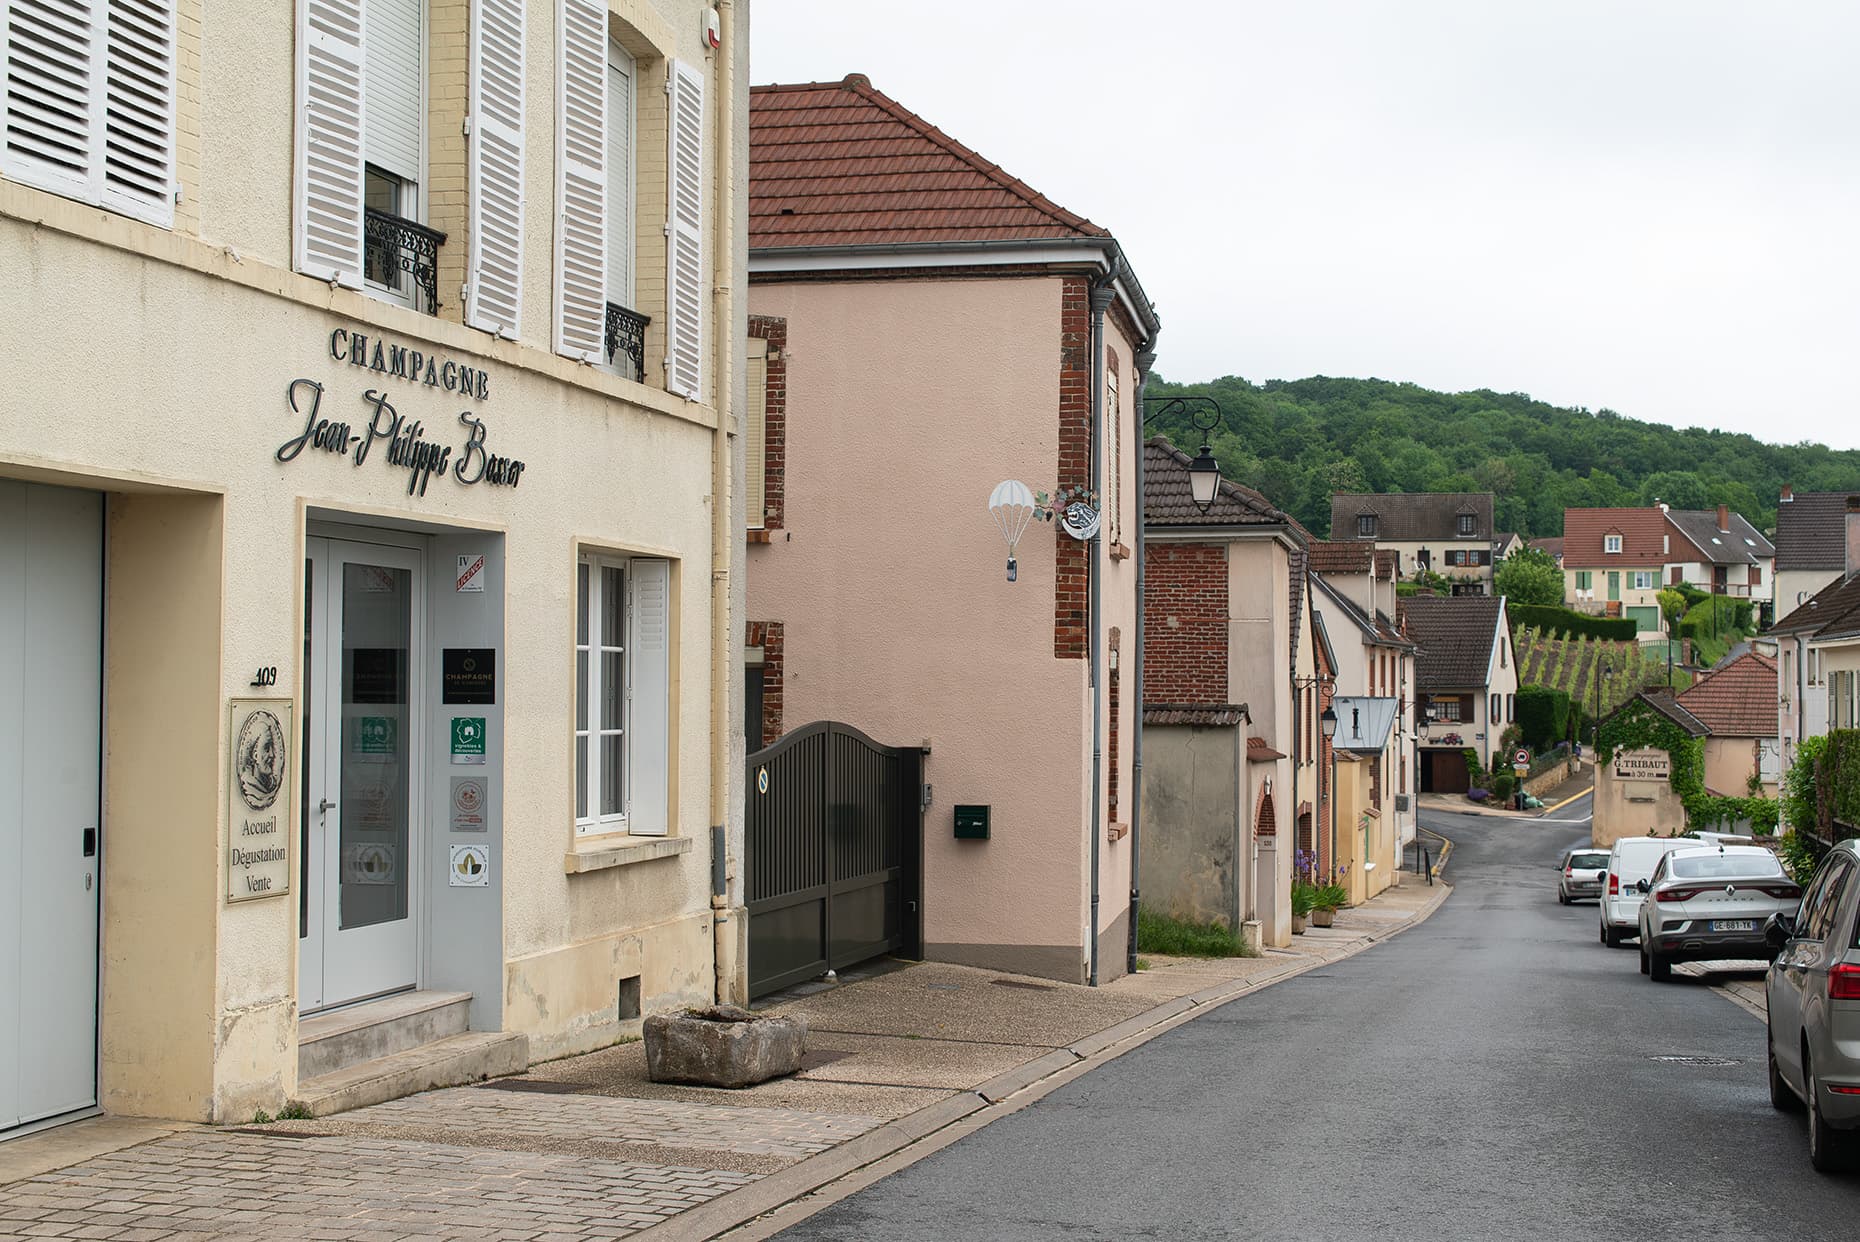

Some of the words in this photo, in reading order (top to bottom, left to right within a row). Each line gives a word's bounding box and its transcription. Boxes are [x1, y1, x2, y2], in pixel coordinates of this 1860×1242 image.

[331, 328, 490, 401] CHAMPAGNE
[276, 378, 452, 497] Jean-Philippe
[254, 666, 277, 686] 109
[446, 673, 493, 681] CHAMPAGNE
[242, 816, 277, 836] Accueil
[231, 845, 286, 869] Dégustation
[246, 875, 272, 892] Vente
